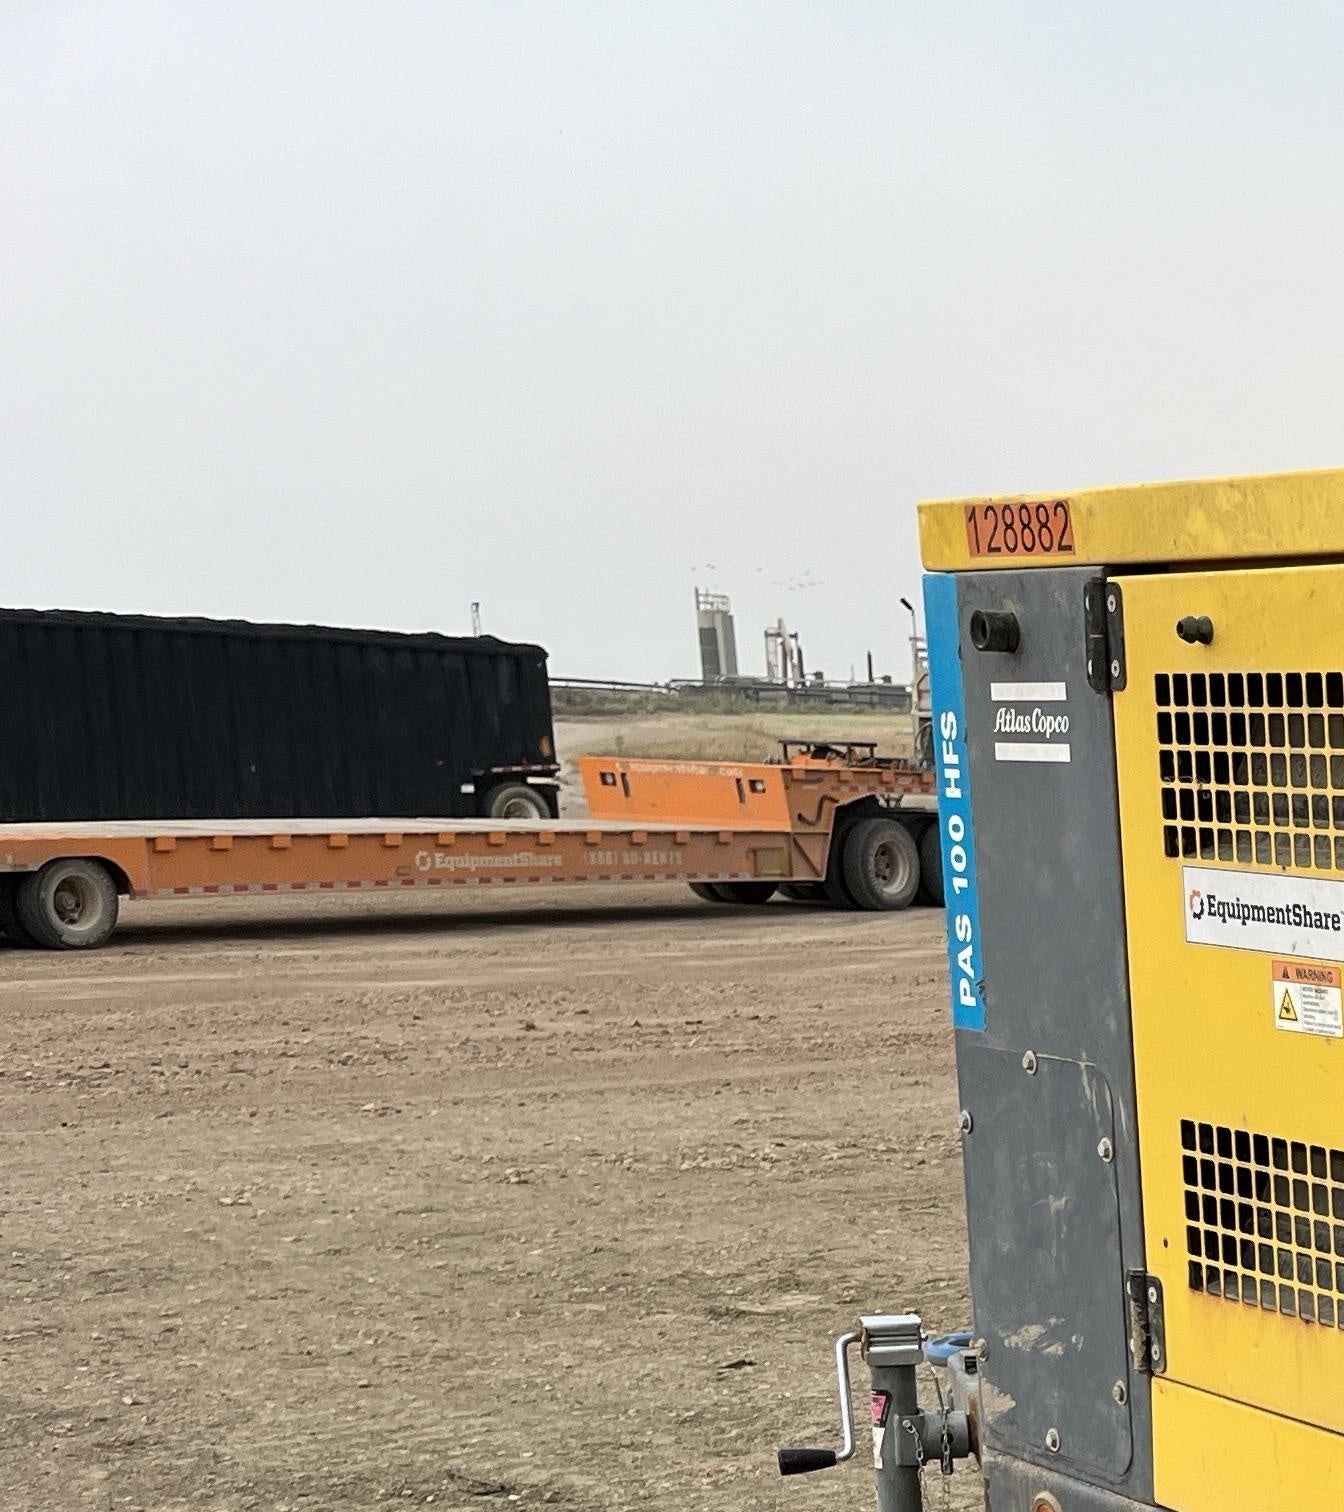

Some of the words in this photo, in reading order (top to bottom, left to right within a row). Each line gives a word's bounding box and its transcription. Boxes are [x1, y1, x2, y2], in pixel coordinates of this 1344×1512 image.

[967, 502, 1073, 554] 128882
[941, 711, 962, 799] HFS
[948, 814, 967, 894] 100
[1206, 894, 1342, 931] EquipmentShare
[955, 914, 977, 1007] PAS
[1295, 968, 1333, 983] WARNING
